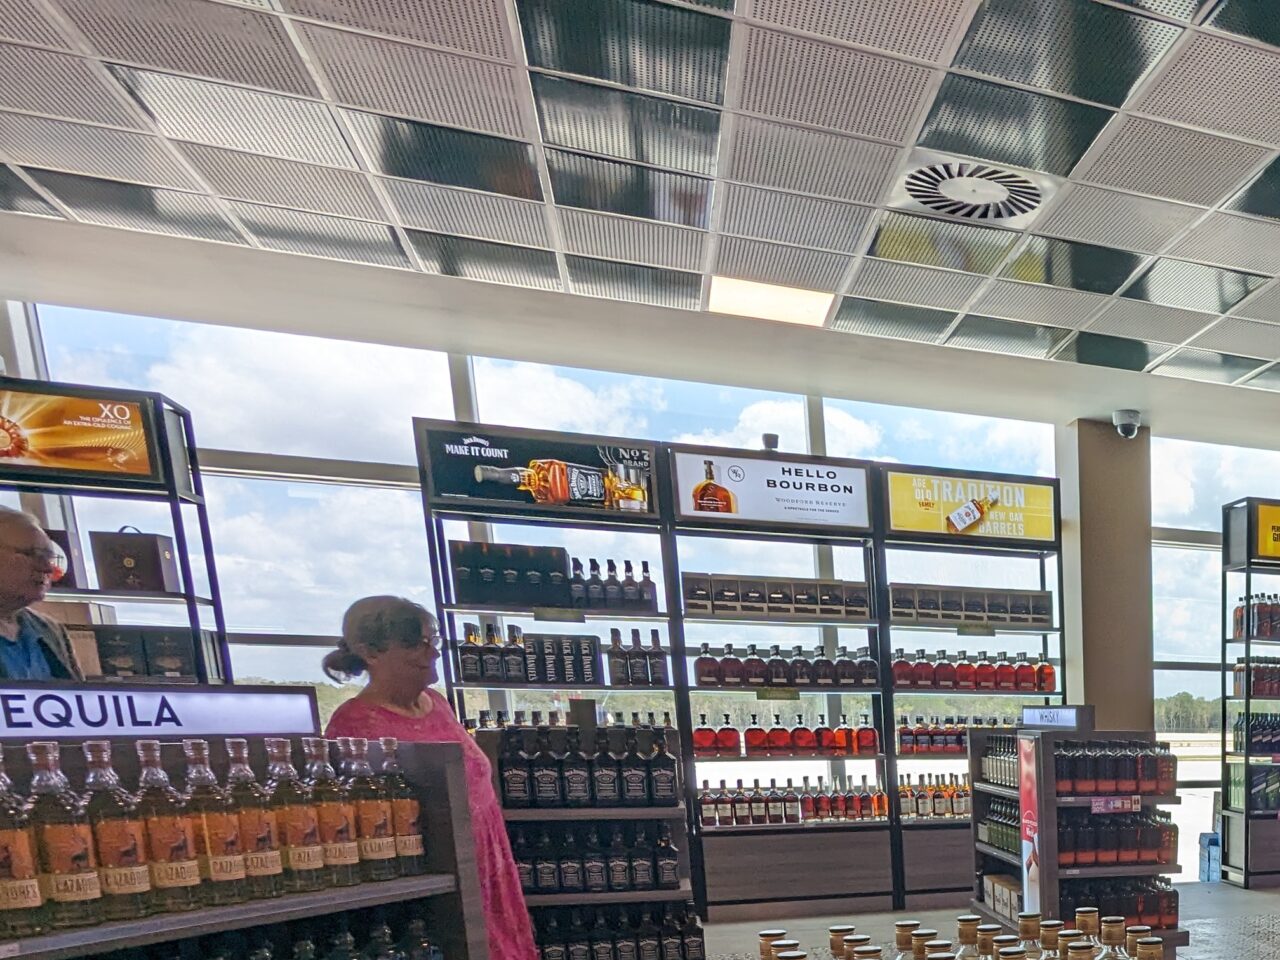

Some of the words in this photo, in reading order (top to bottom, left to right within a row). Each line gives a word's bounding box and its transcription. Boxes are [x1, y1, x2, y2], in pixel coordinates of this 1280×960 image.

[99, 403, 130, 420] XO
[445, 444, 470, 456] MAKE
[471, 446, 480, 457] IT
[481, 447, 509, 459] COUNT
[781, 466, 837, 480] HELLO
[766, 479, 853, 494] BOURBON
[912, 478, 926, 488] AGE
[915, 489, 932, 500] OLD
[931, 480, 1024, 508] TRADITION
[989, 511, 1006, 520] NEW
[1009, 512, 1024, 522] OAK
[978, 522, 1024, 536] BARRELS
[0, 694, 183, 728] EQUILA
